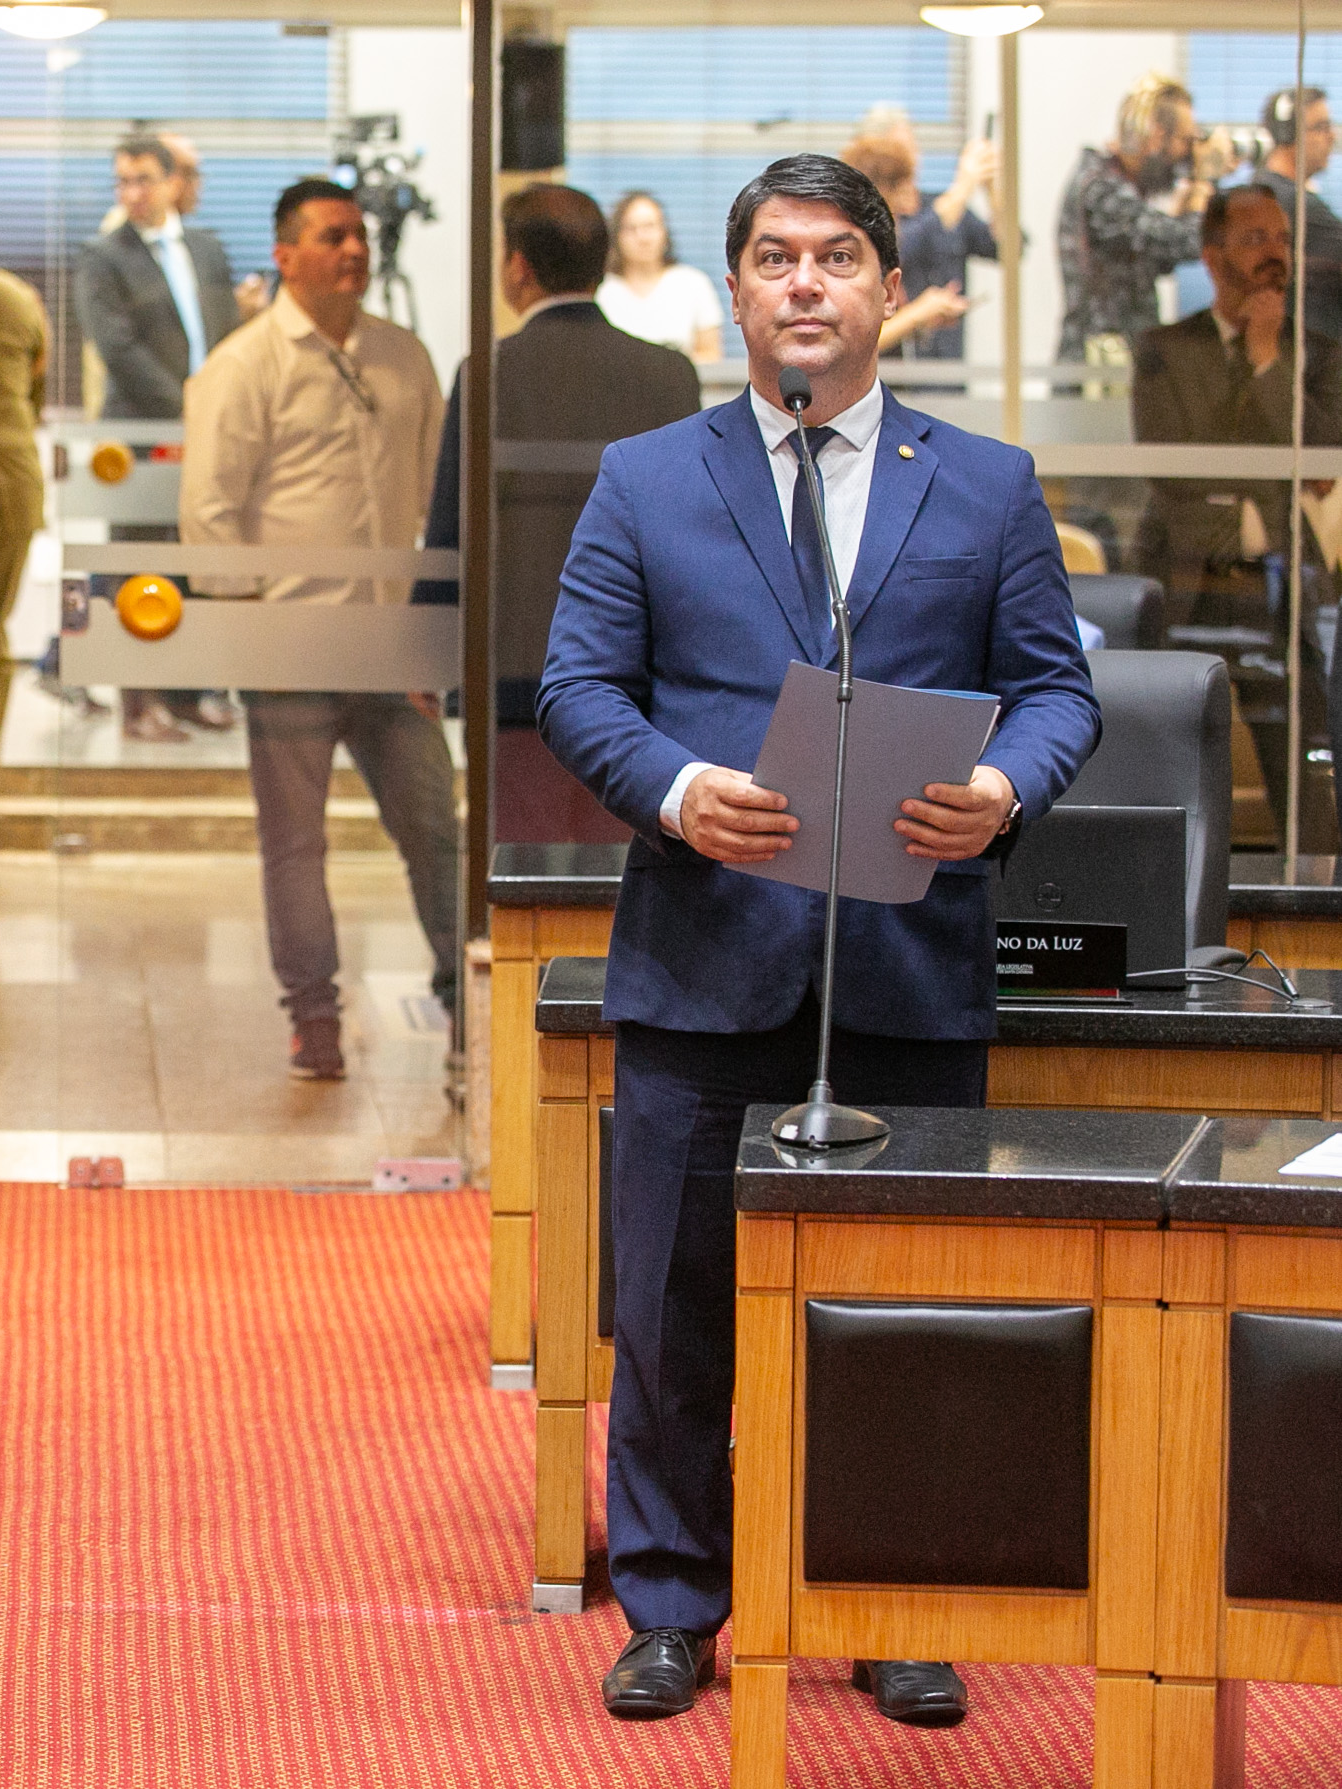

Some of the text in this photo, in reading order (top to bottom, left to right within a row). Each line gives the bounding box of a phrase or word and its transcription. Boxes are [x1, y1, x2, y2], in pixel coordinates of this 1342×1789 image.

[996, 935, 1083, 950] NO DA LUZ
